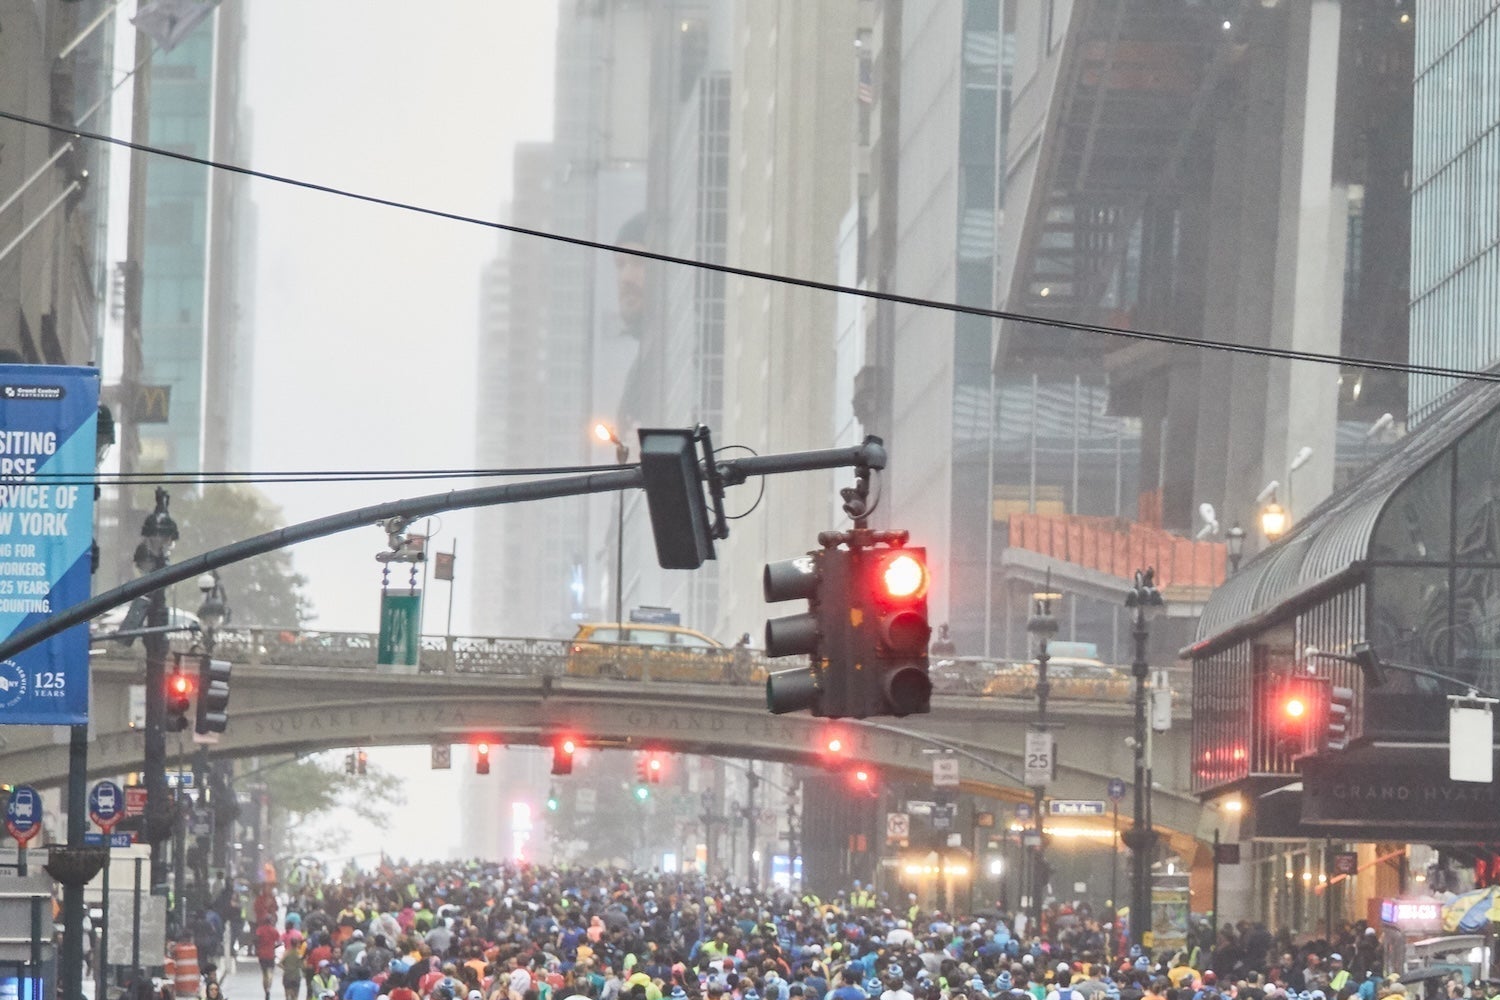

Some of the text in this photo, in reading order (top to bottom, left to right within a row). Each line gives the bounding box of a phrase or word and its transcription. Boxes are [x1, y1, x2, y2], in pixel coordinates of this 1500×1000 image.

[55, 485, 79, 510] OF
[19, 512, 68, 536] YORK
[15, 544, 35, 558] FOR
[17, 581, 50, 595] YEARS
[34, 672, 65, 688] 125
[1028, 753, 1048, 769] 25
[1333, 786, 1496, 801] GRAND HYATT
